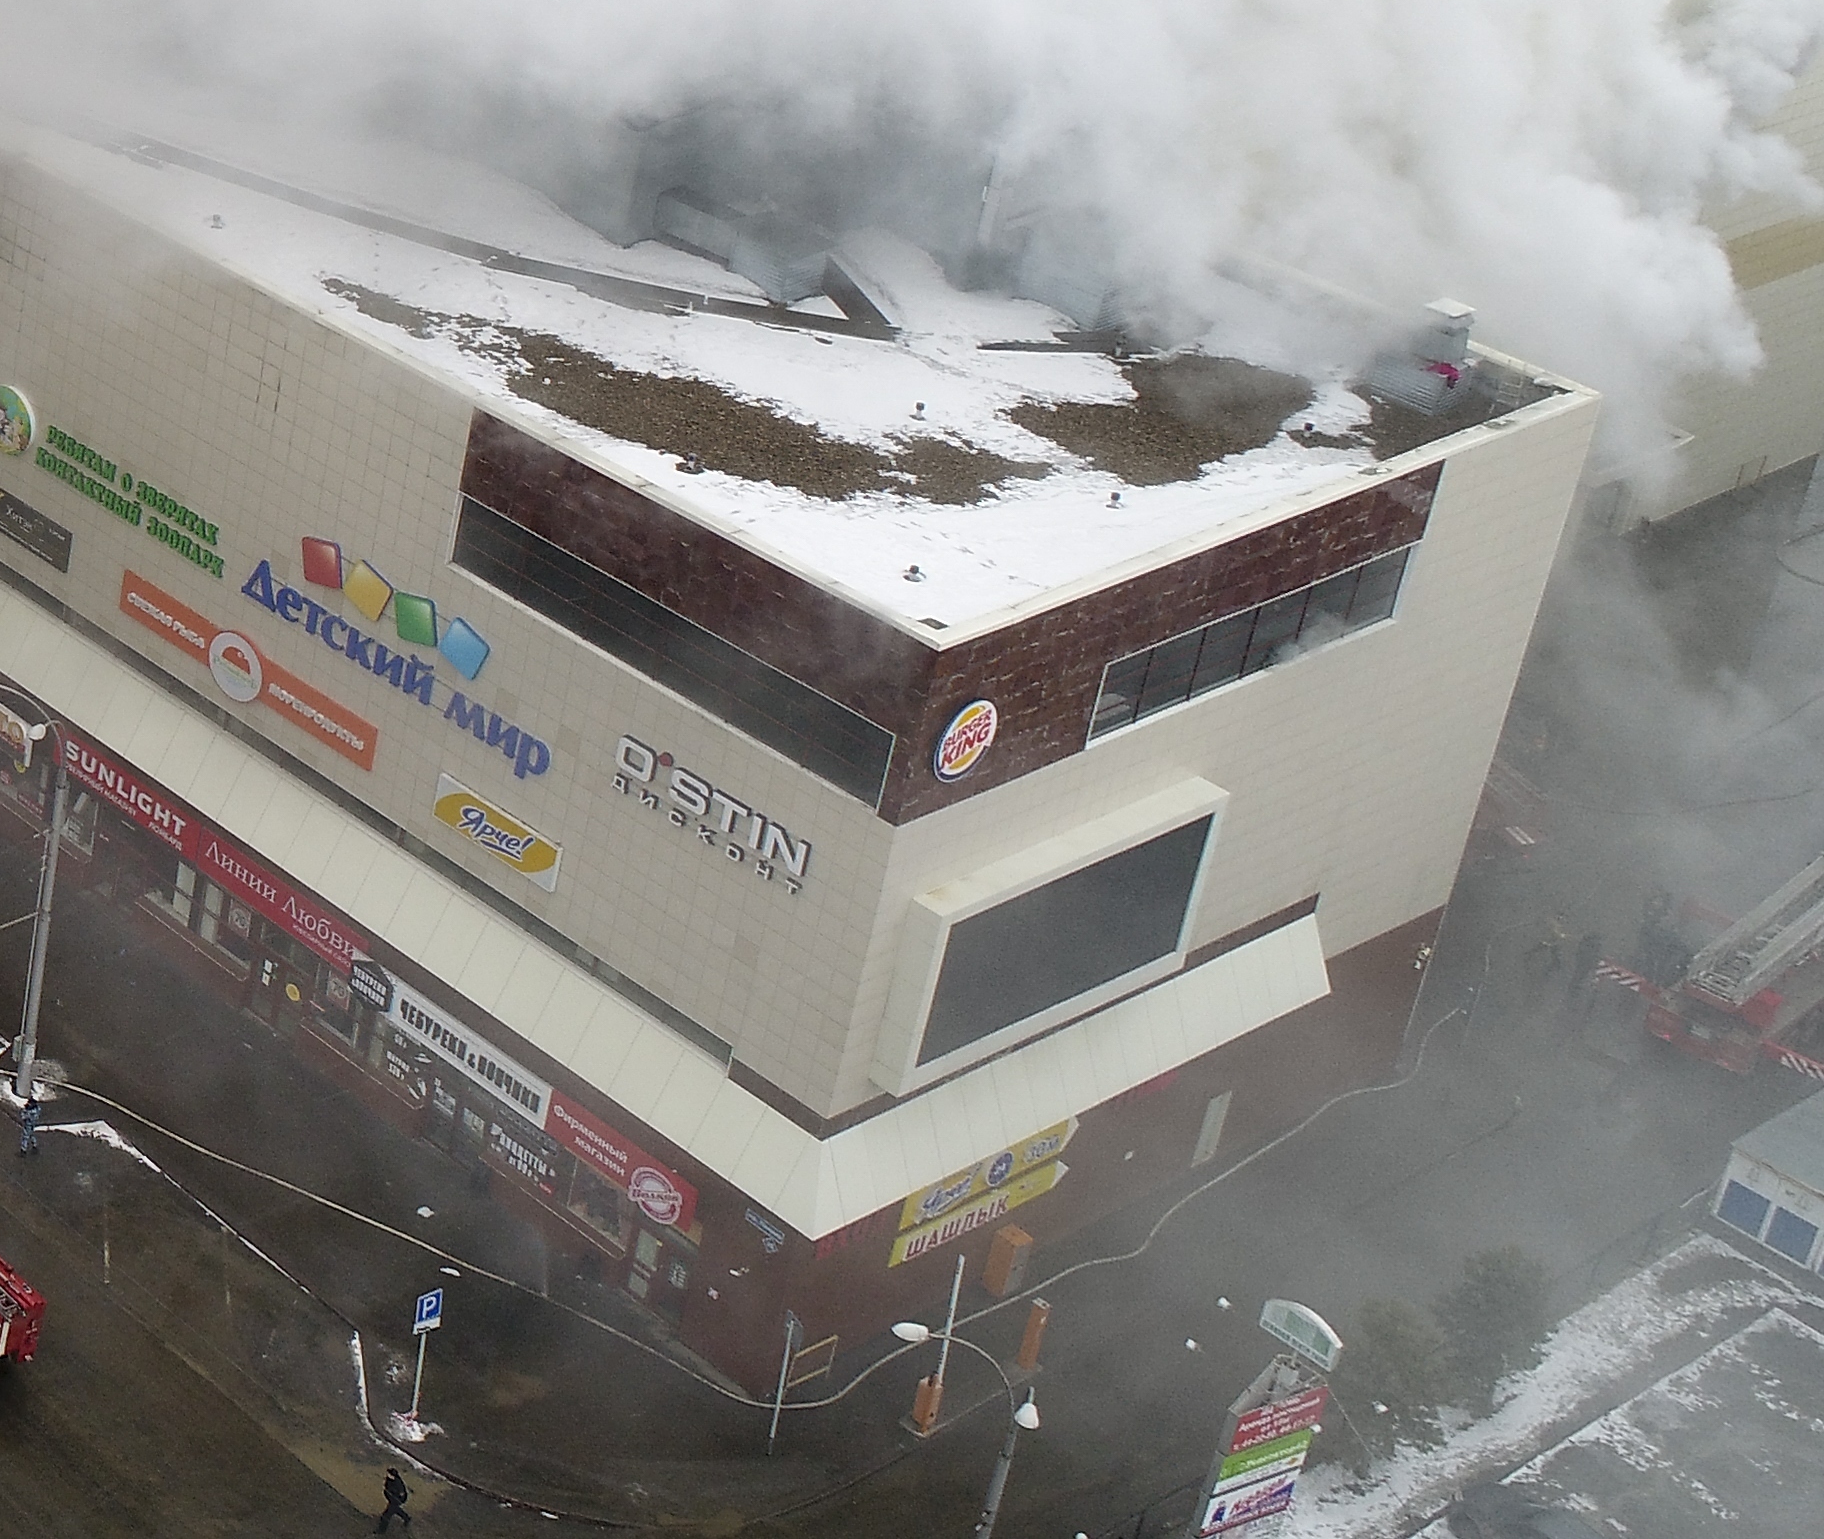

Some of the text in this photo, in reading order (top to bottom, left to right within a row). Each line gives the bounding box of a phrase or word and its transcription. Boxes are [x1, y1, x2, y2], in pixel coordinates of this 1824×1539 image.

[35, 446, 226, 579] КОНТАКТНЫЙ ЗООПАРК
[120, 472, 133, 492] О
[136, 480, 220, 546] ЗВЕРЯТАХ
[241, 559, 551, 780] Детский мир
[941, 722, 992, 769] KING
[942, 709, 992, 753] BURGER
[65, 740, 187, 837] SUNLIGHT
[457, 806, 536, 859] Ярче!
[610, 773, 803, 896] ДИСКОНТ
[204, 840, 278, 904] Линии
[400, 997, 542, 1115] ЧЕБУРЕКИ & ПОНЧИКИ
[552, 1104, 629, 1163] Фирменный
[573, 1135, 627, 1177] магазин
[903, 1193, 1011, 1260] ШАШЛЫК
[422, 1295, 438, 1320] P
